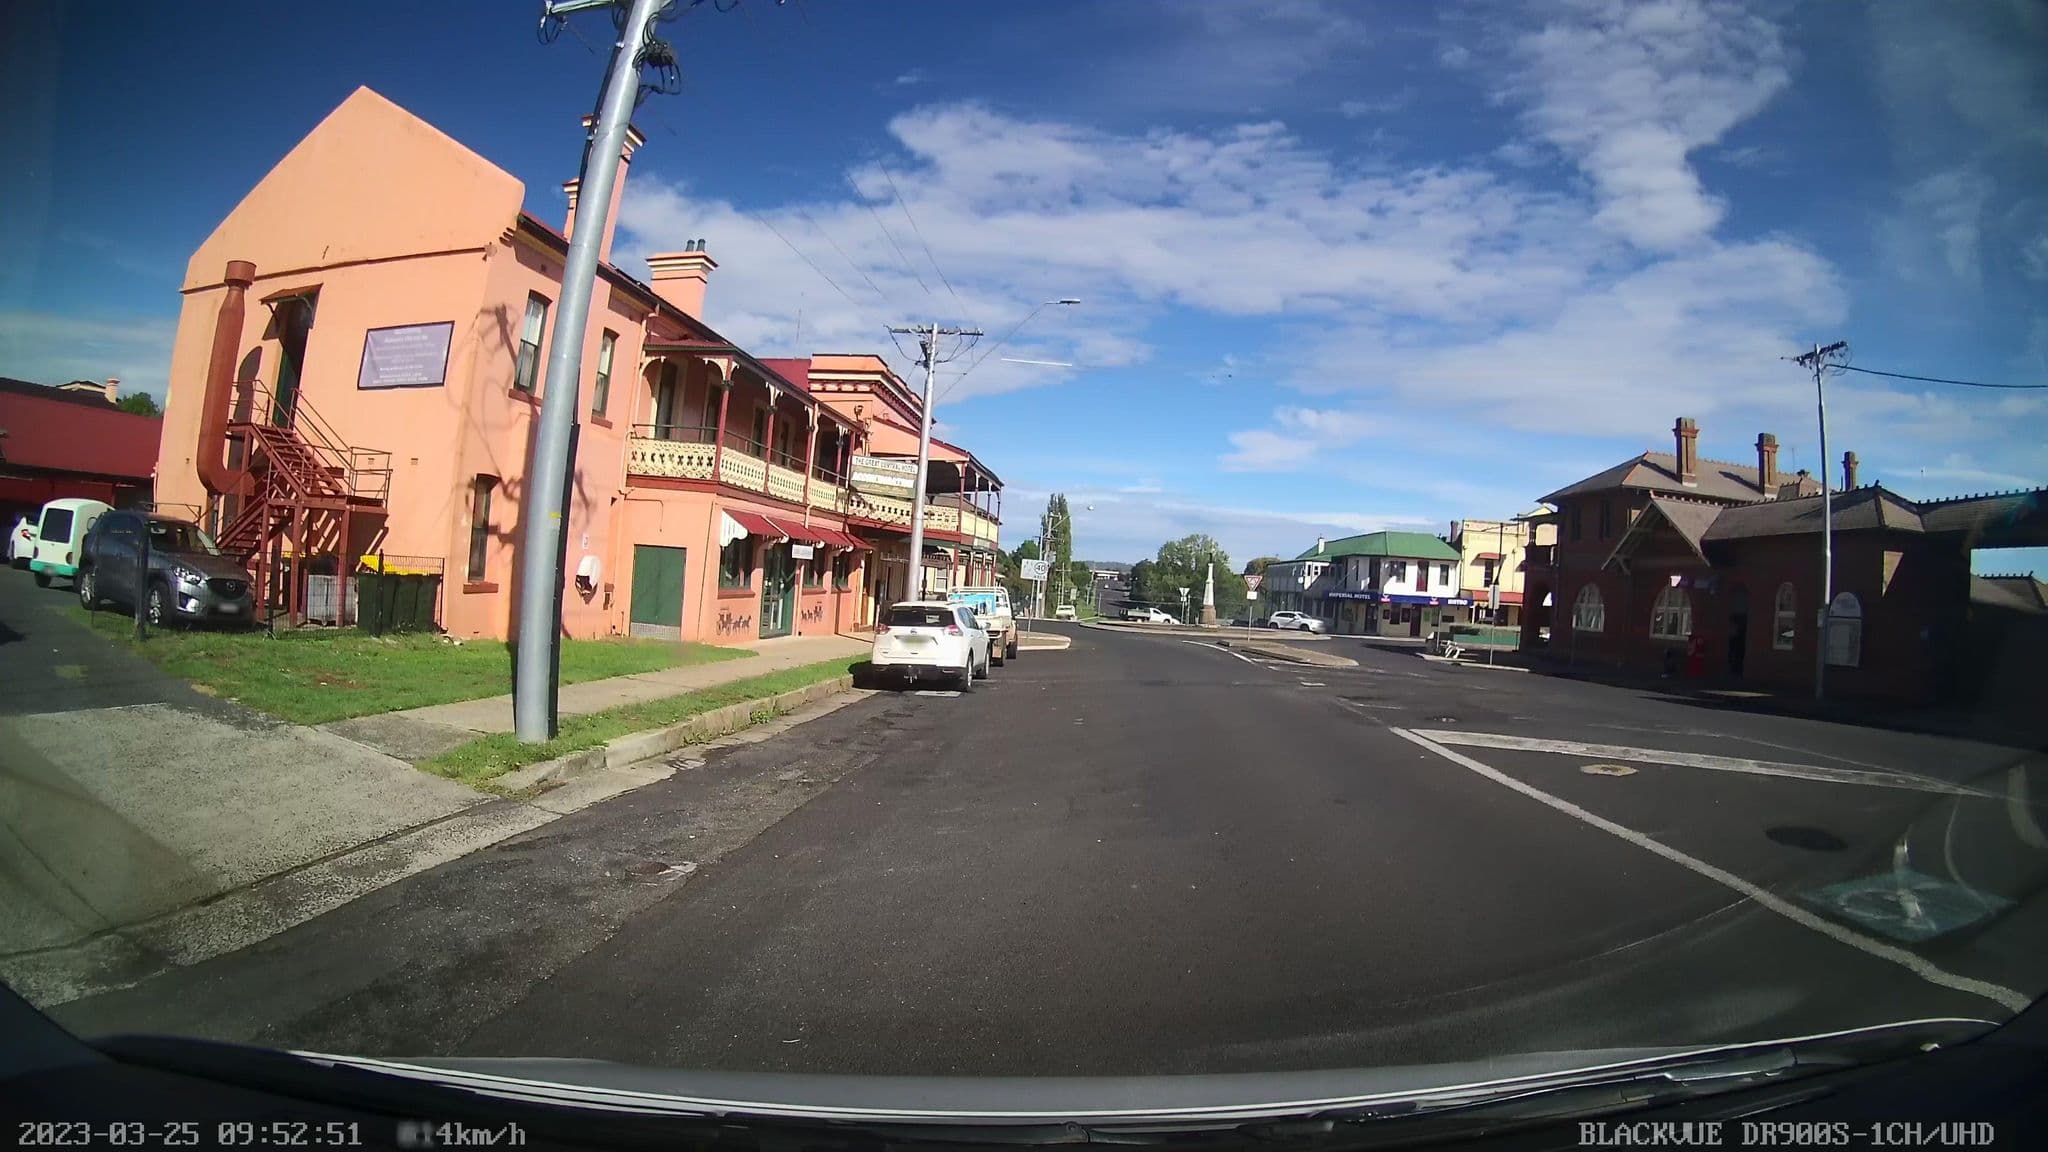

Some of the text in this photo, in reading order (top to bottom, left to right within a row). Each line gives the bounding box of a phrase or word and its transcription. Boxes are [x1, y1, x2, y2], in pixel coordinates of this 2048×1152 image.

[855, 457, 916, 473] THE GREAT CENTRAL HOTEL
